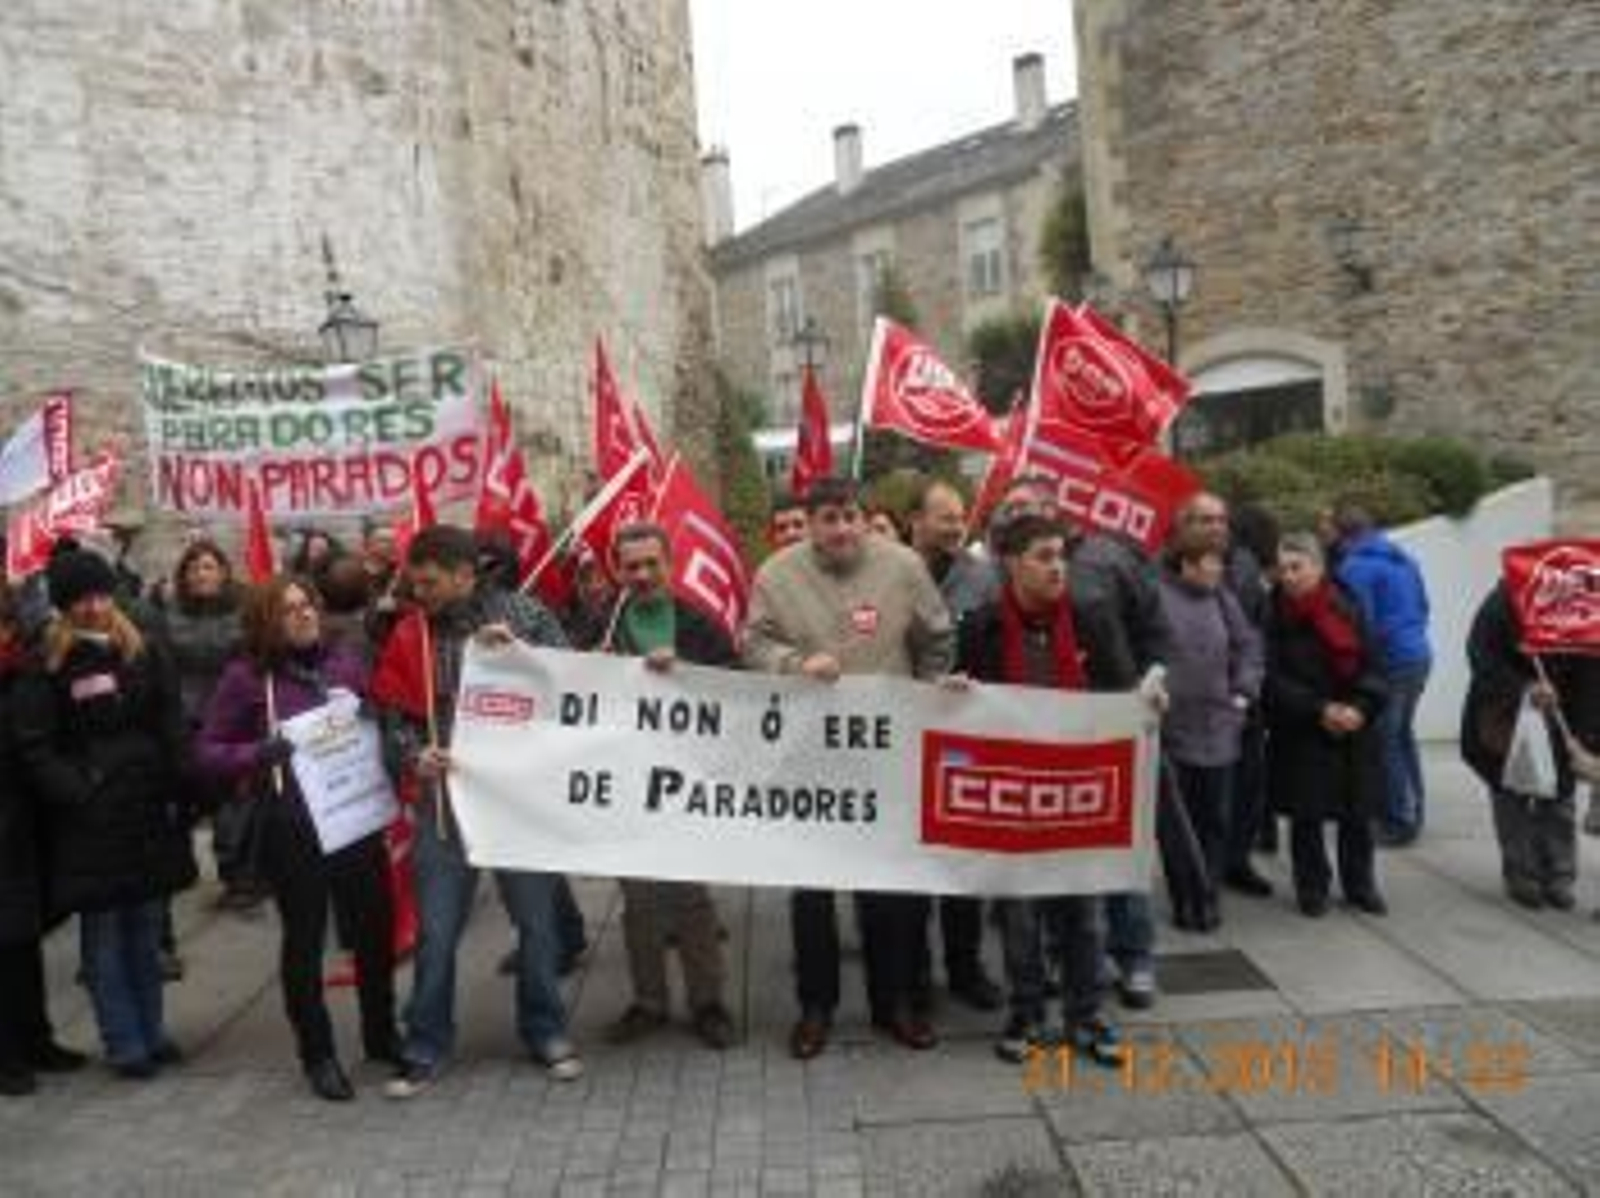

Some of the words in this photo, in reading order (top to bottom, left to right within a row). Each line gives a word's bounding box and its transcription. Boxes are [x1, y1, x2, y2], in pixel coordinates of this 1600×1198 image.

[359, 353, 466, 402] SER
[161, 402, 436, 451] PARADORES
[156, 454, 244, 512] NON
[262, 435, 479, 512] PARADOS
[560, 692, 599, 727] DI
[637, 698, 722, 736] NON
[824, 715, 892, 750] ERE
[568, 770, 612, 806] DE
[950, 774, 1104, 816] CCOO
